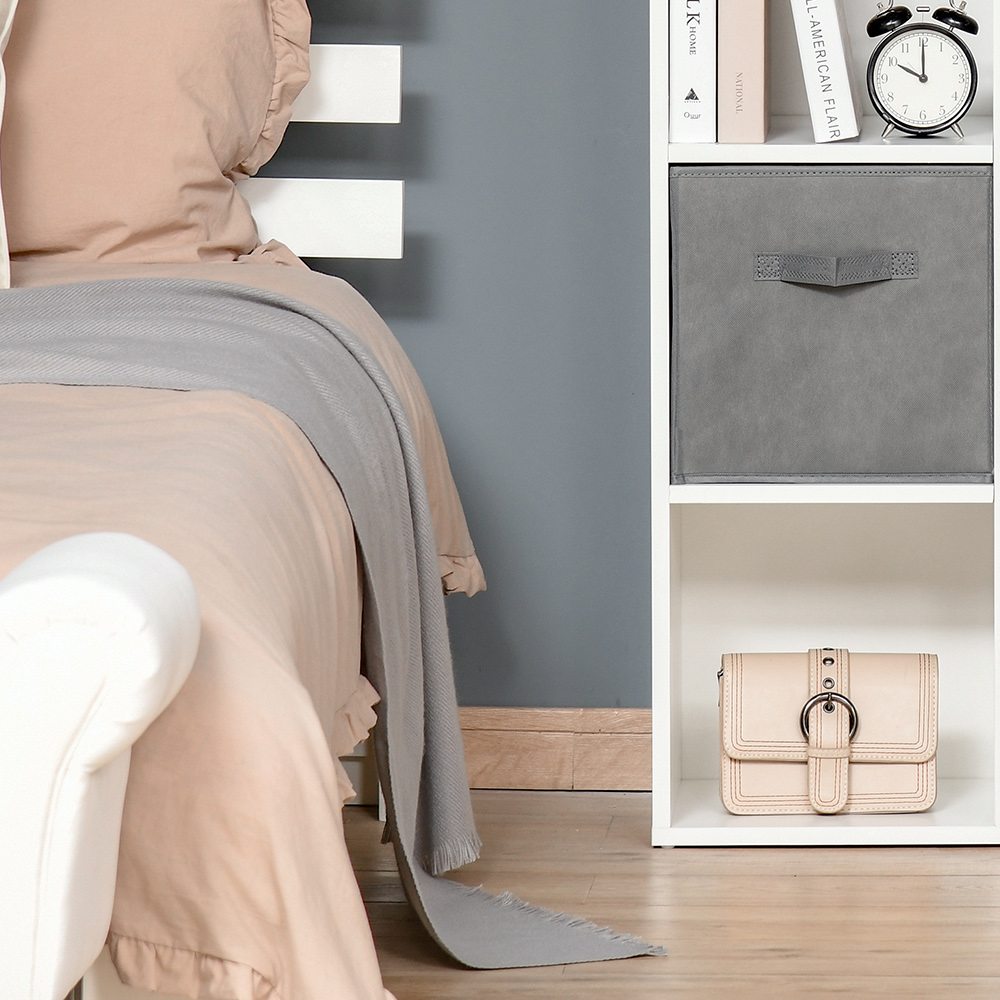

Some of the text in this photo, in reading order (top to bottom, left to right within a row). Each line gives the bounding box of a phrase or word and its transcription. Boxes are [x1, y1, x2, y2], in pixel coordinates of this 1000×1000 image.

[689, 26, 697, 56] HOME
[918, 37, 929, 47] 12
[901, 43, 909, 53] 11
[940, 42, 943, 52] 1
[888, 56, 898, 67] 10
[952, 55, 959, 65] 2
[881, 74, 889, 84] 9
[958, 74, 965, 84] 3
[735, 72, 744, 114] NATIONAL
[887, 92, 895, 102] 8
[951, 91, 958, 101] 4
[902, 105, 909, 115] 7
[919, 110, 927, 120] 6
[939, 106, 946, 116] 5
[823, 98, 842, 139] FLAIR
